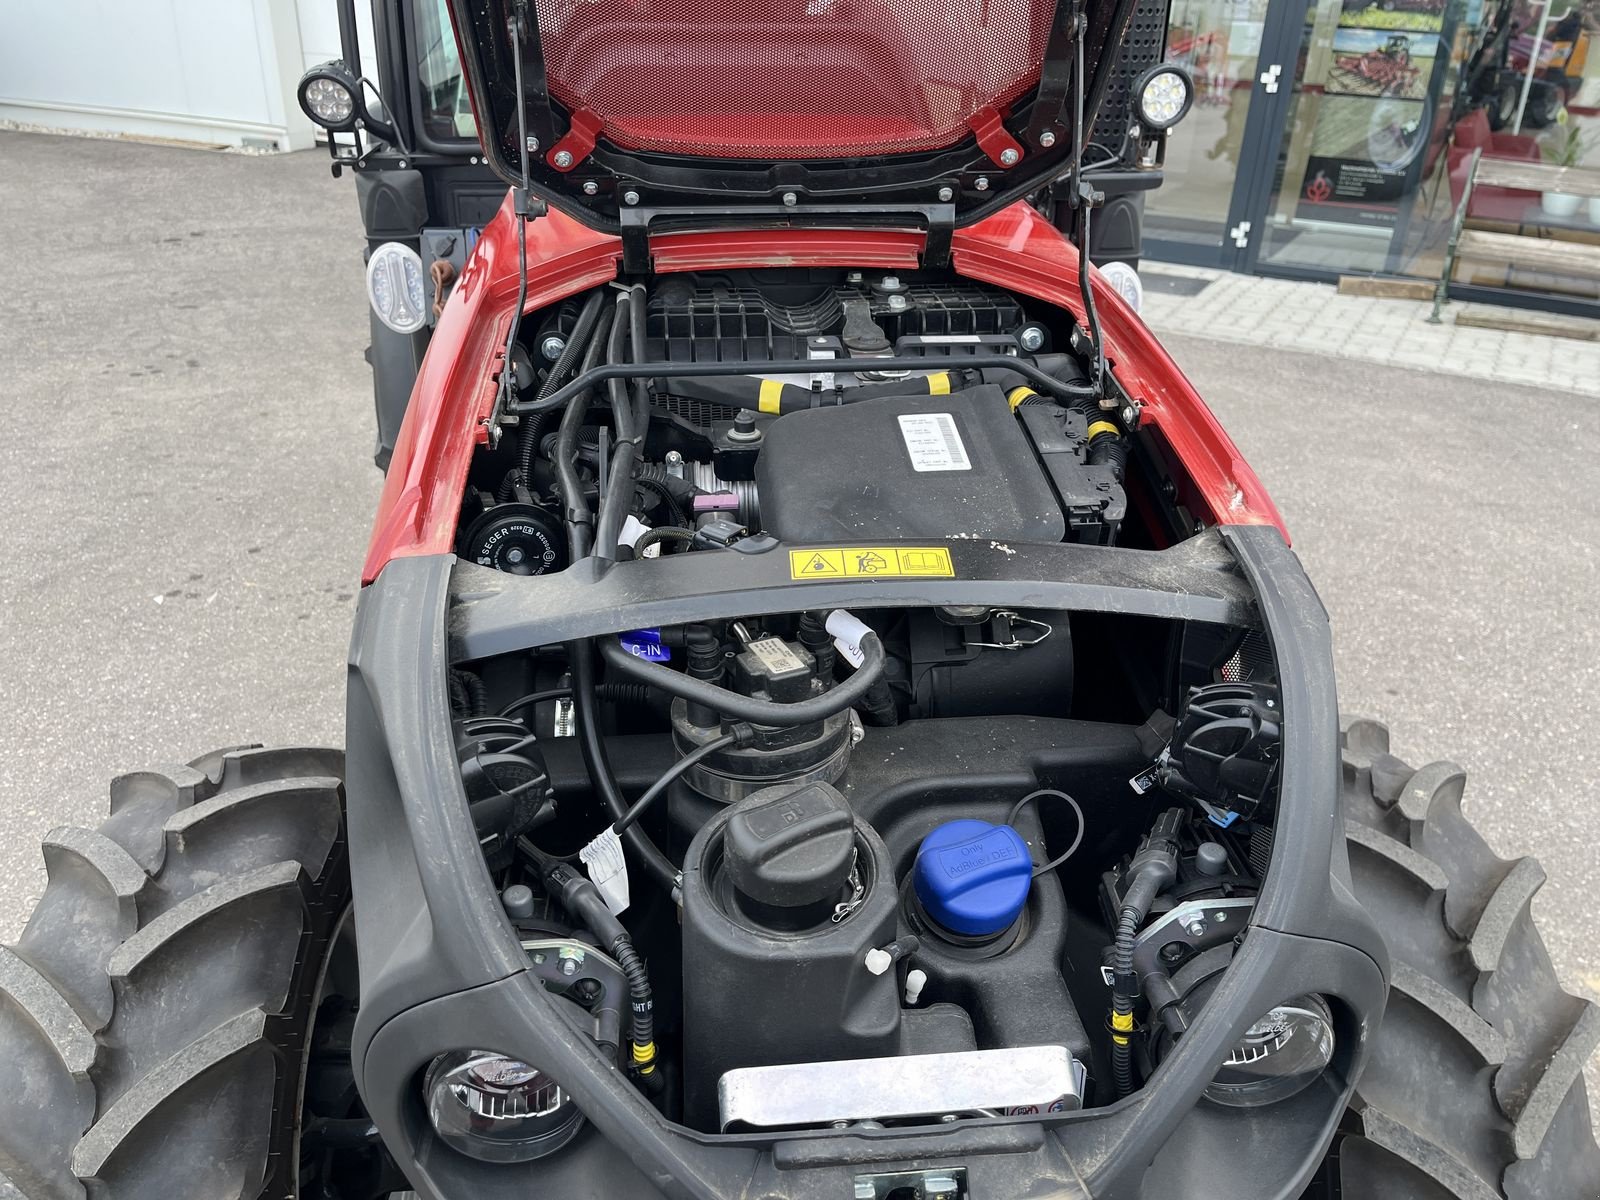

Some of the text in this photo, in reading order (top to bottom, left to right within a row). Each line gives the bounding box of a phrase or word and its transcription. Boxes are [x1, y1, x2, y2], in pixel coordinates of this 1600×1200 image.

[482, 528, 509, 555] SEGER
[632, 644, 661, 656] C-IN
[961, 843, 984, 857] Only
